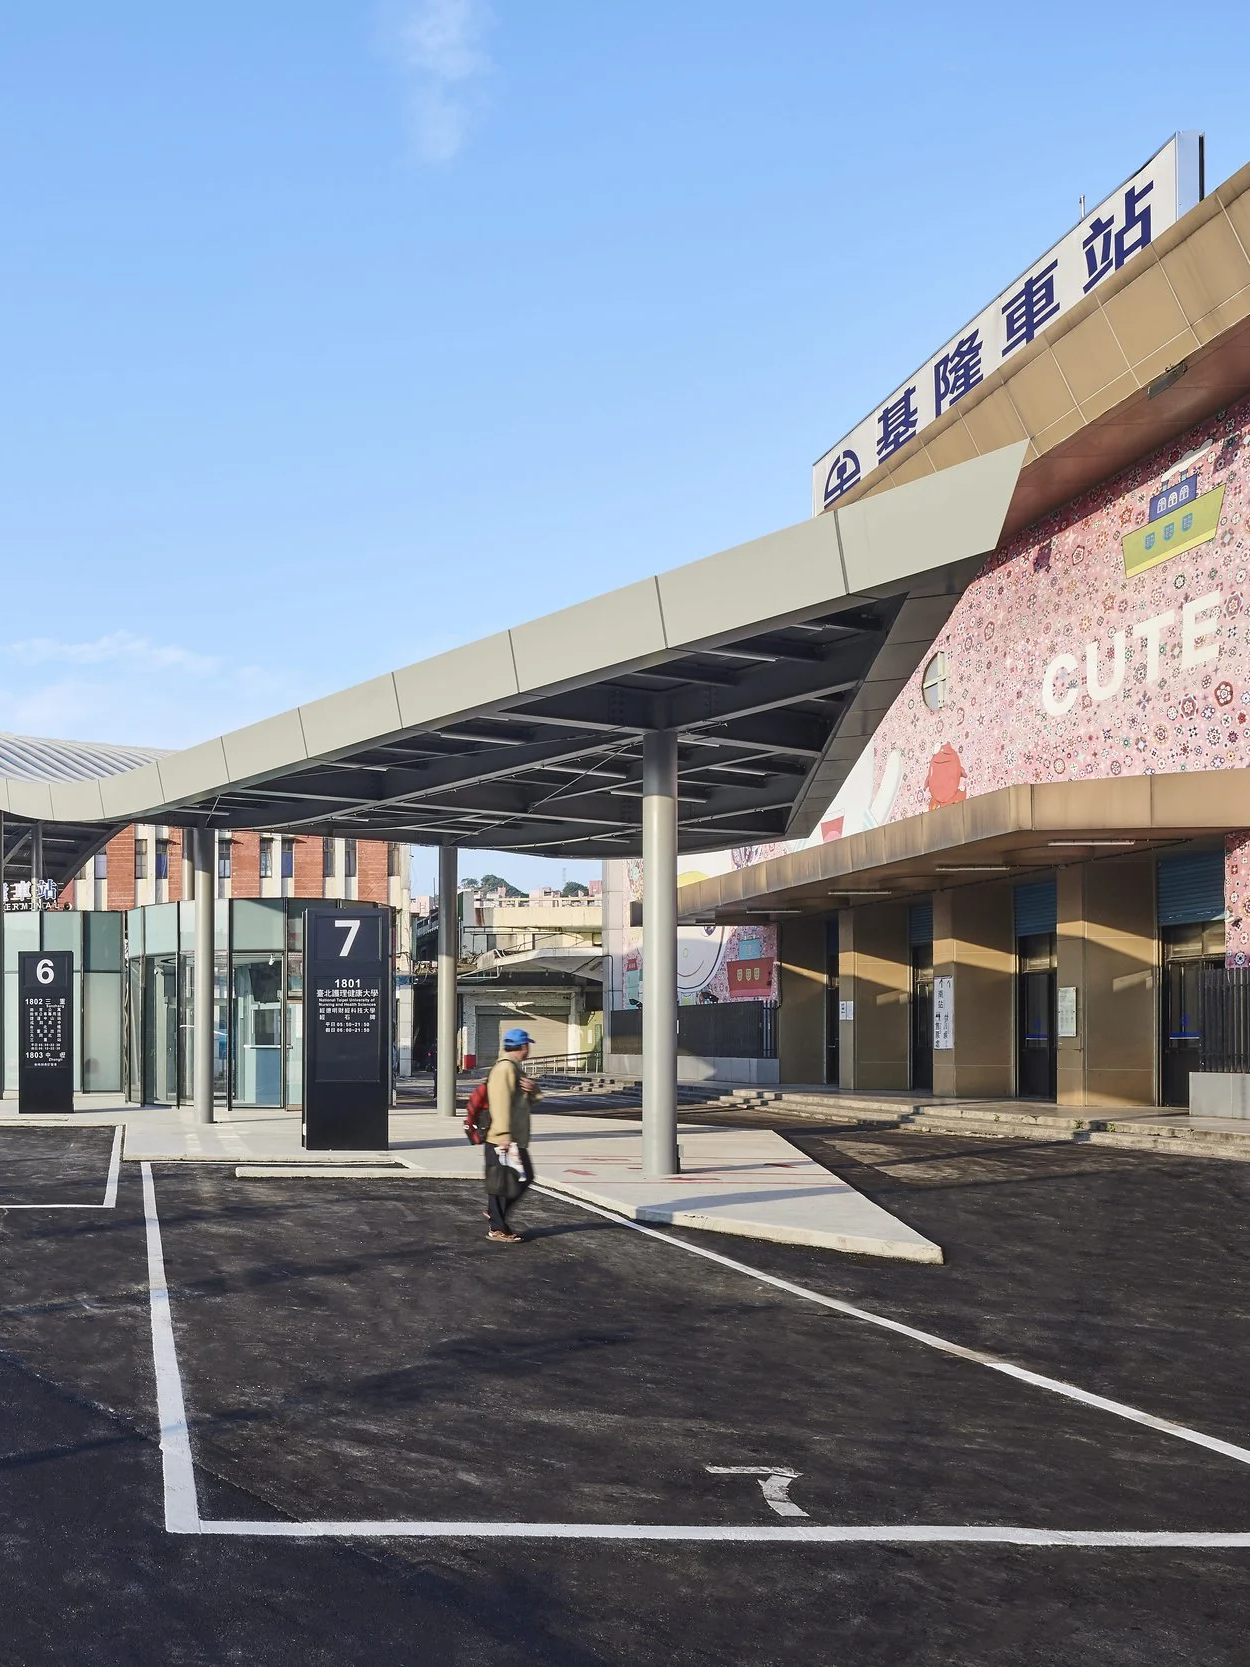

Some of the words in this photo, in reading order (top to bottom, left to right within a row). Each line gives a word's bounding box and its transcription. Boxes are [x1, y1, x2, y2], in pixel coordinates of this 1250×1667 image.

[877, 180, 1154, 466] 基隆車站
[1042, 590, 1221, 717] CUTE
[3, 899, 60, 911] ERMINAL
[334, 920, 360, 957] 7
[36, 959, 54, 985] 6
[334, 979, 360, 988] 1801
